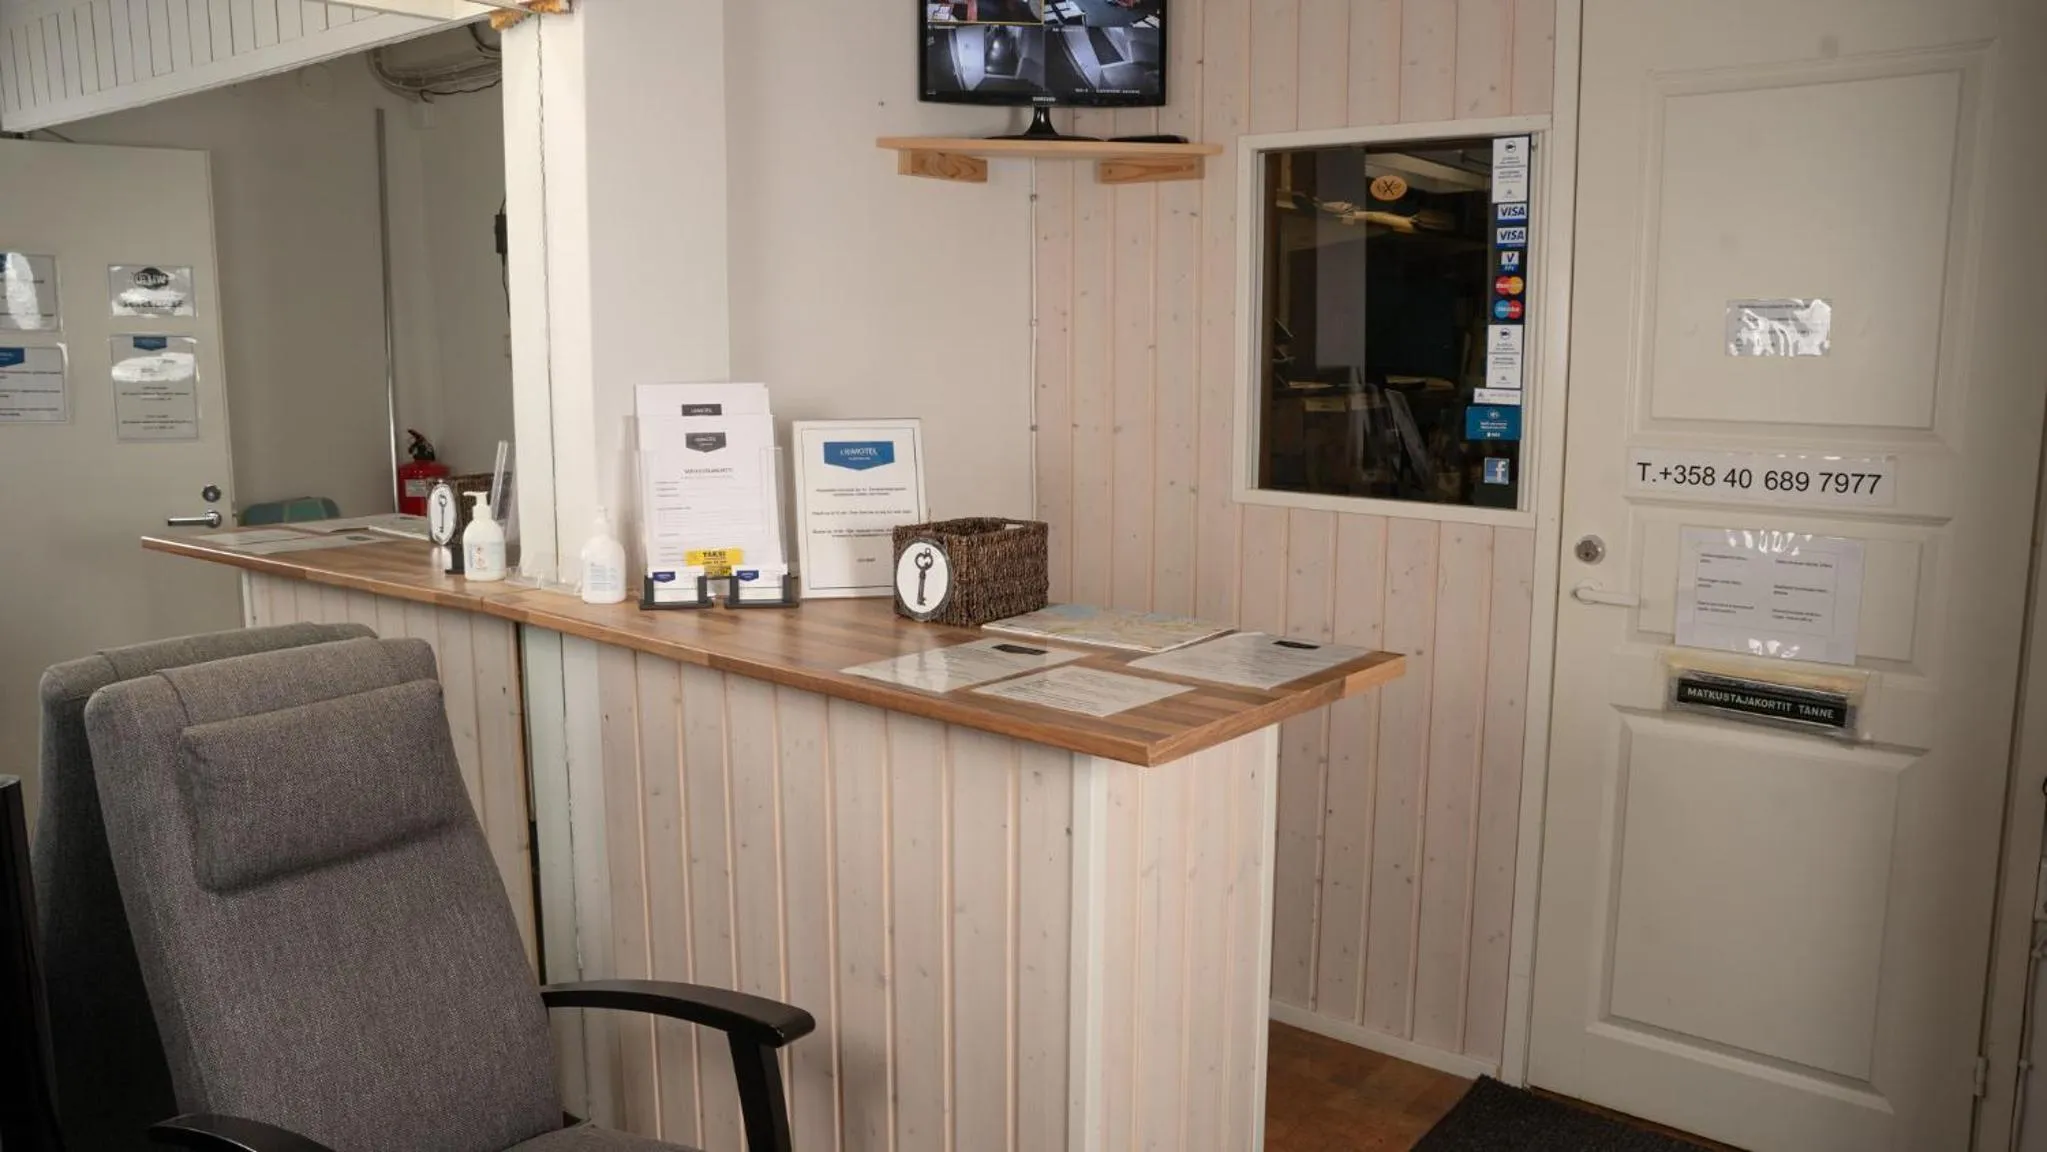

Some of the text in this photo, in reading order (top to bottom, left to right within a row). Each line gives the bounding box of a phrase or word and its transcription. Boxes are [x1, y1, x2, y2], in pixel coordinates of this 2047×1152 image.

[1500, 206, 1525, 217] VISA
[1500, 230, 1525, 241] VISA
[1506, 253, 1515, 263] V
[1636, 462, 1882, 495] T.+358 40 689 7977
[1687, 687, 1834, 719] MATKUSTAJAKORTIT TANNE
